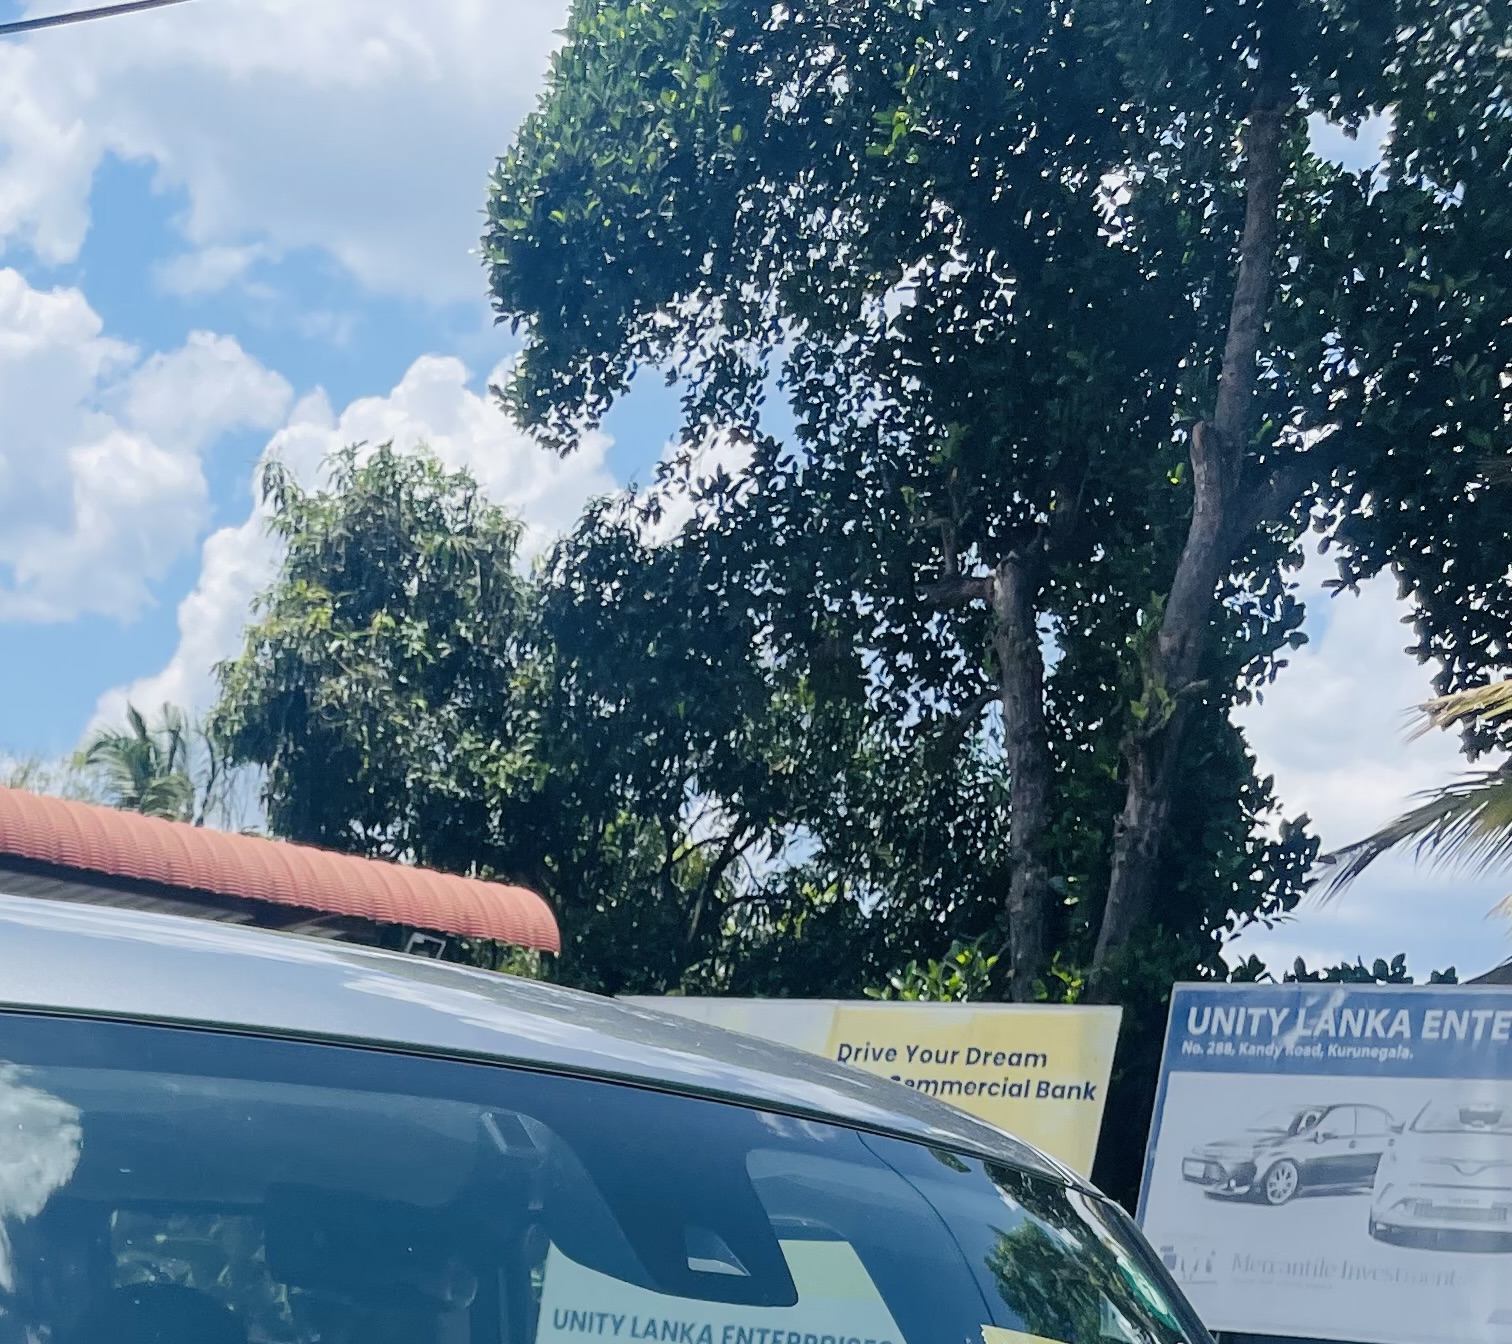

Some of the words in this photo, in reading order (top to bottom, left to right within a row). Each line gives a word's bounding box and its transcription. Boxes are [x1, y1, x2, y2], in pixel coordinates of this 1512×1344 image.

[1187, 1005, 1289, 1036] UNITY
[1295, 1007, 1412, 1039] LANKA
[1421, 1009, 1512, 1041] ENTE
[837, 1042, 898, 1064] Drive
[906, 1044, 961, 1065] Your
[965, 1047, 1048, 1068] Dream
[1239, 1042, 1281, 1060] Kandy
[890, 1075, 1031, 1098] ommercial
[1035, 1080, 1098, 1101] Bank
[553, 1307, 625, 1337] UNITY
